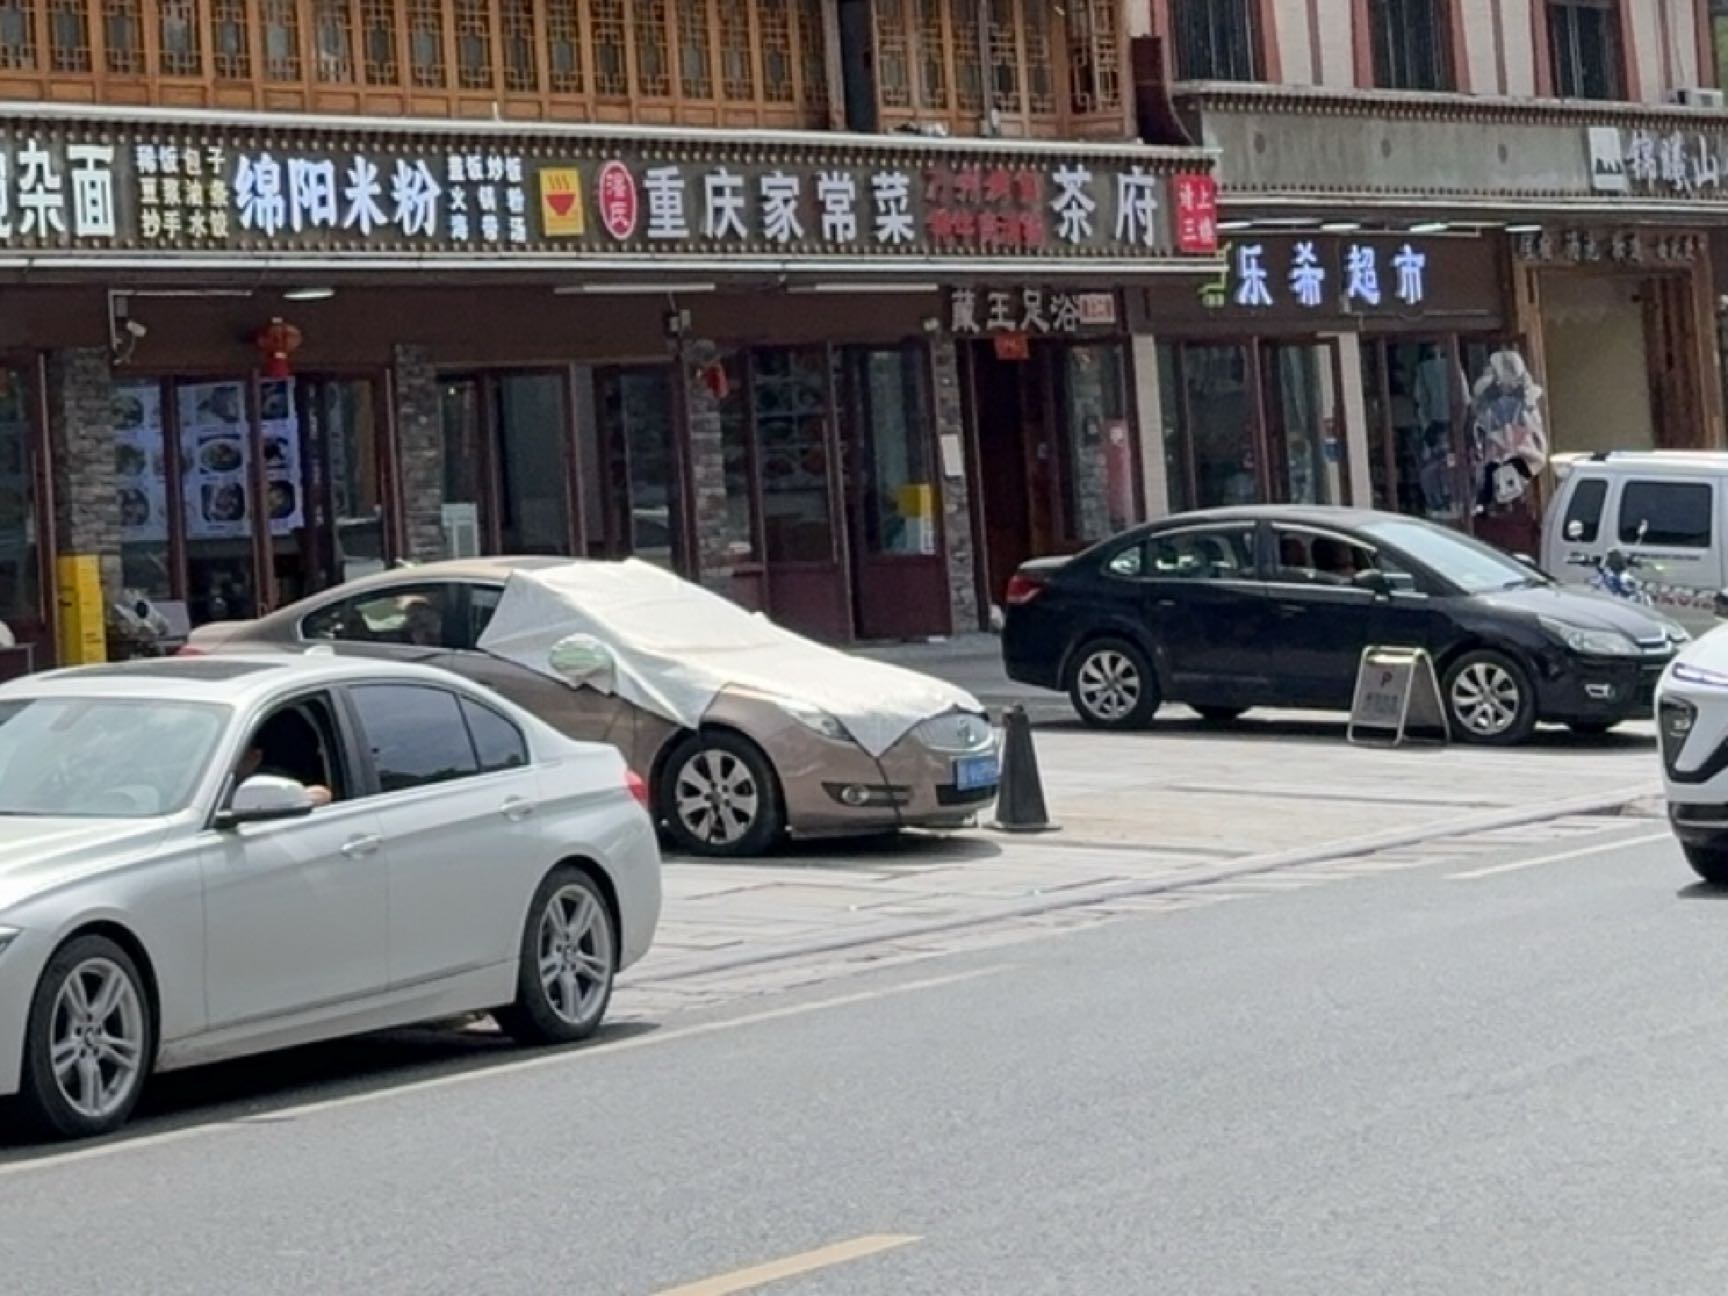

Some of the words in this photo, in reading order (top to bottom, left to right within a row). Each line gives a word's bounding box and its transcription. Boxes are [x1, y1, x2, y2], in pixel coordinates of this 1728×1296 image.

[234, 153, 441, 238] 绵阳米粉
[644, 166, 915, 246] 重庆家常菜
[1050, 164, 1158, 248] 茶府
